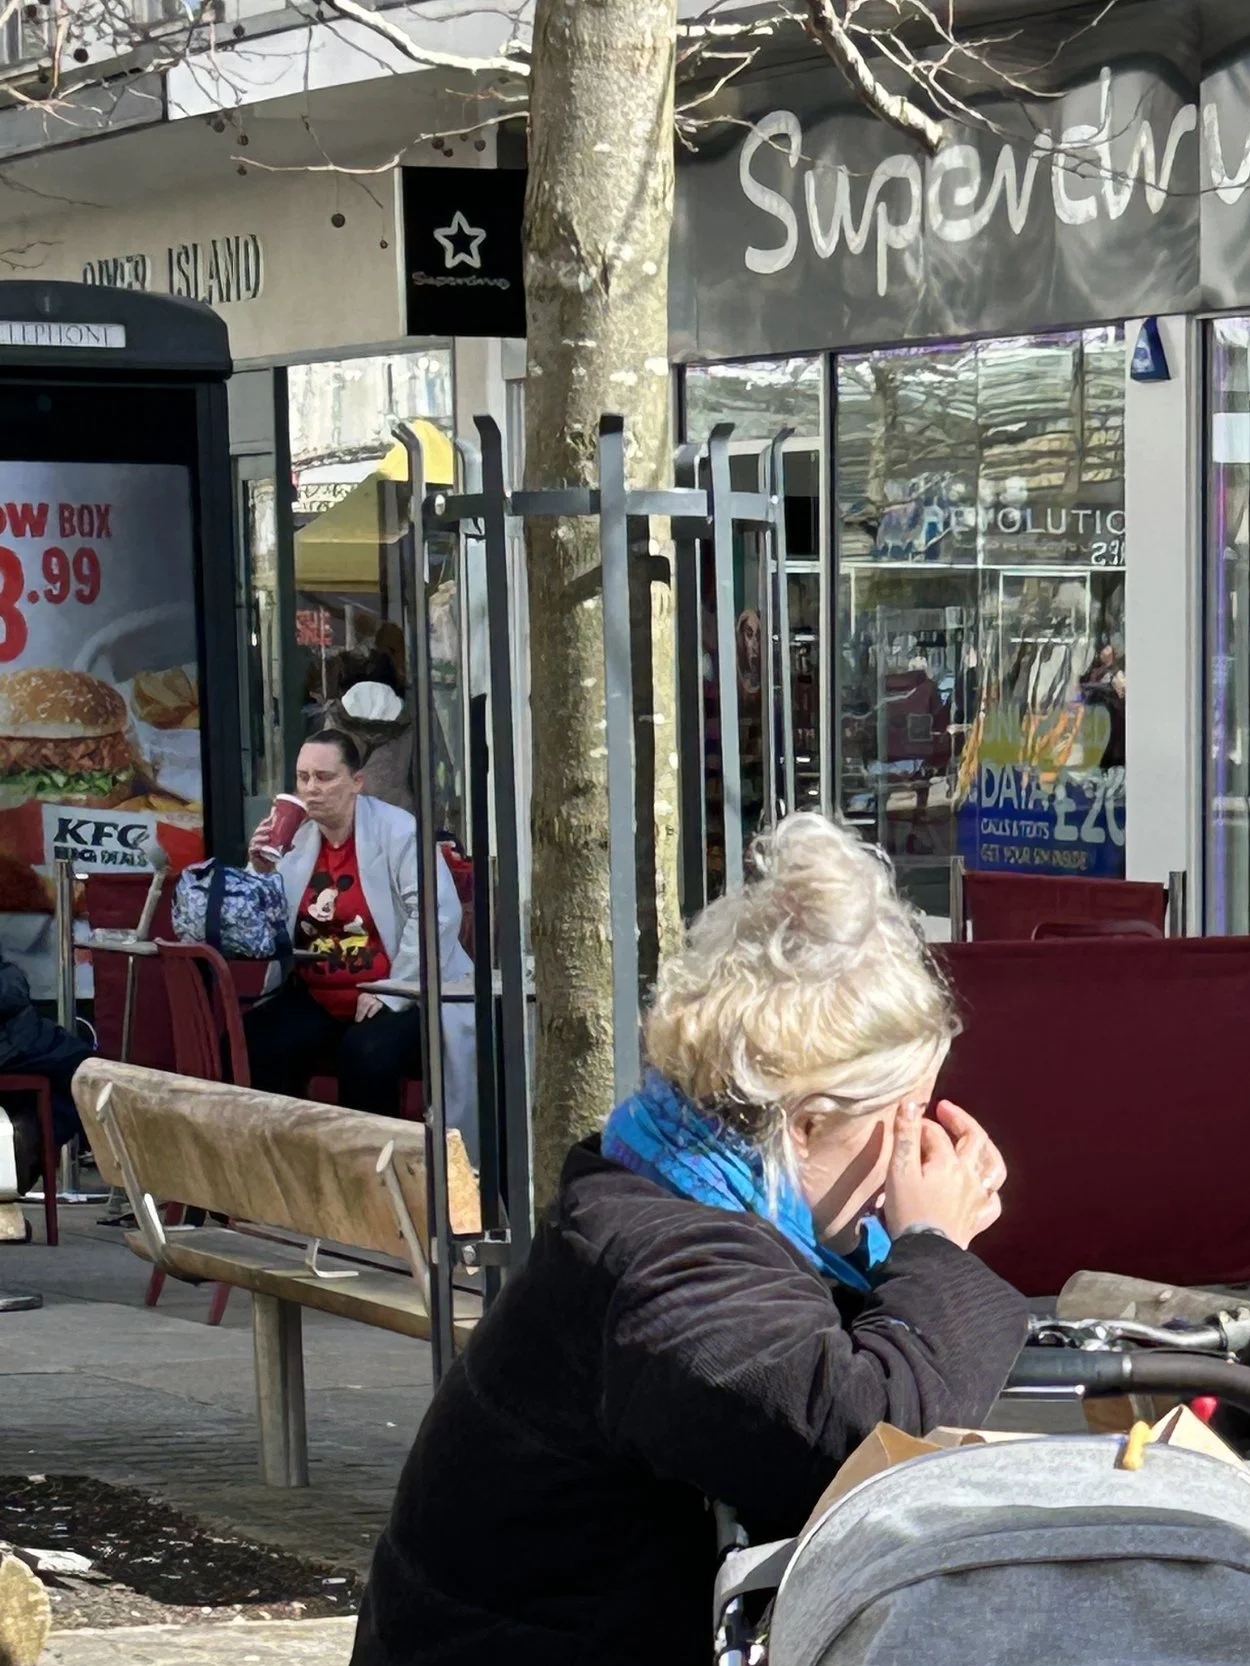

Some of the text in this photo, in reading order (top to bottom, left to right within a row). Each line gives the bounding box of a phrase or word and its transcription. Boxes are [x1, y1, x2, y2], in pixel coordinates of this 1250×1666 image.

[167, 234, 264, 305] ISLAND
[0, 323, 110, 345] LEPHONE
[0, 502, 112, 539] W BOX
[53, 817, 150, 850] KFC
